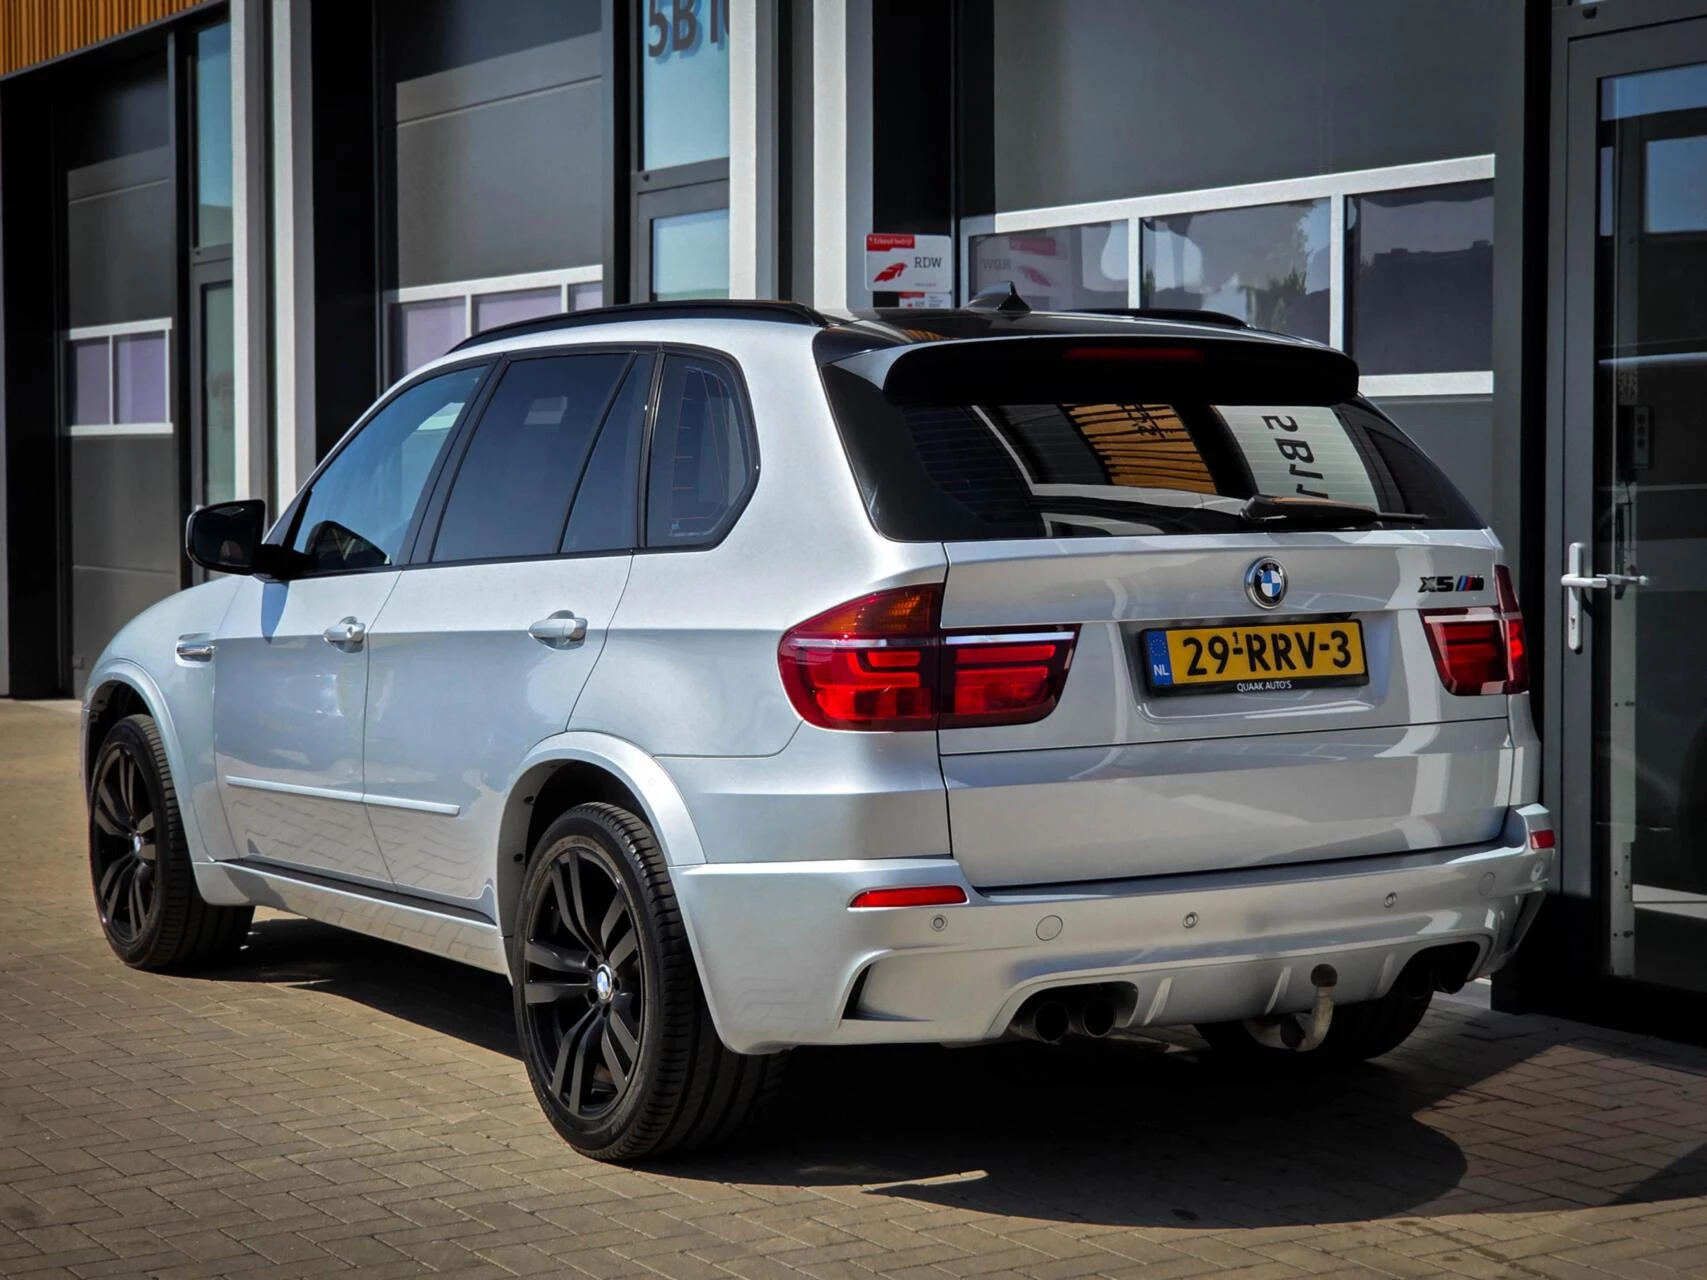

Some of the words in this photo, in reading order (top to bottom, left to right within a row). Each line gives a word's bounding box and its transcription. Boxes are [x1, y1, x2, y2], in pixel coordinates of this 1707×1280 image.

[913, 256, 942, 269] RDW
[1418, 576, 1454, 592] X5
[1182, 630, 1352, 677] 29-RRV-3
[1154, 664, 1170, 676] NL
[1236, 682, 1264, 692] QUAAK
[1265, 680, 1292, 690] AUTO'S
